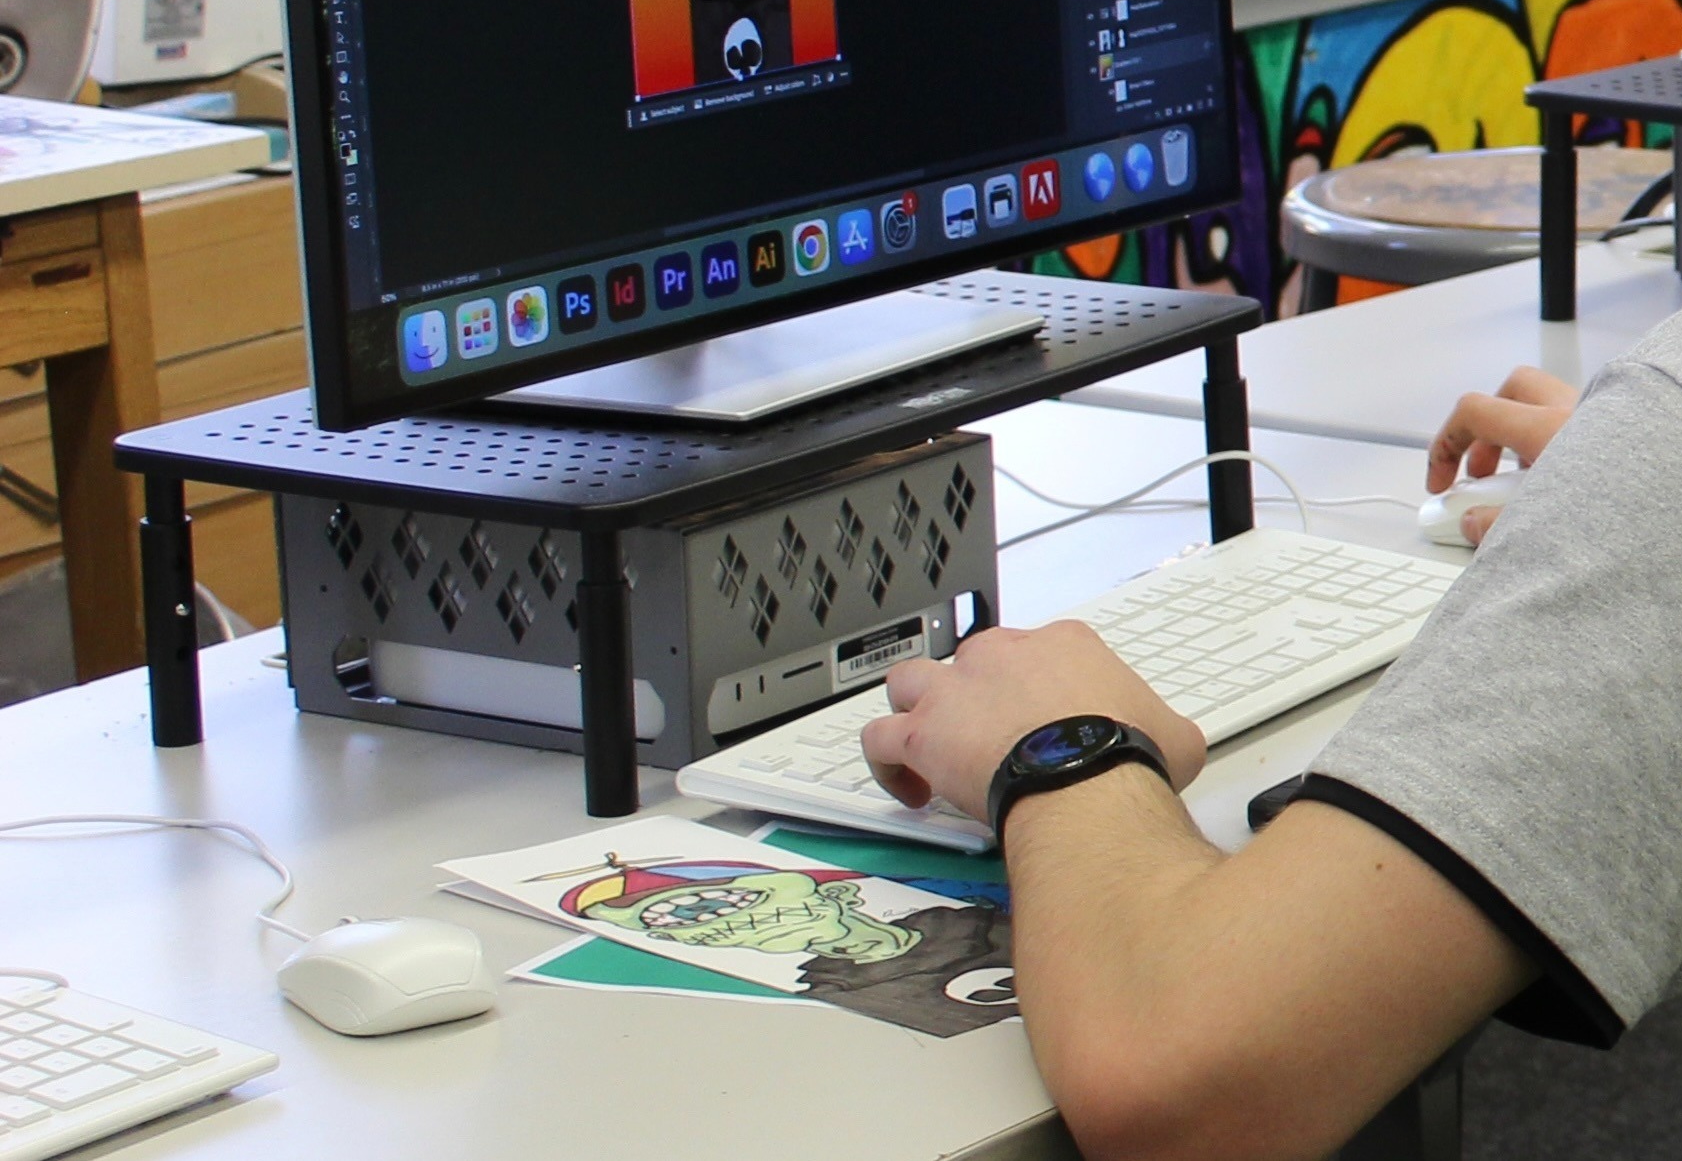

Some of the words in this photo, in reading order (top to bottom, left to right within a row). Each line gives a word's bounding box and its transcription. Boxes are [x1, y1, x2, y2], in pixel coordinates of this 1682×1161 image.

[706, 257, 737, 285] An
[755, 242, 777, 272] Ai
[613, 275, 635, 307] Id
[663, 268, 687, 295] Pr
[565, 291, 592, 319] Ps
